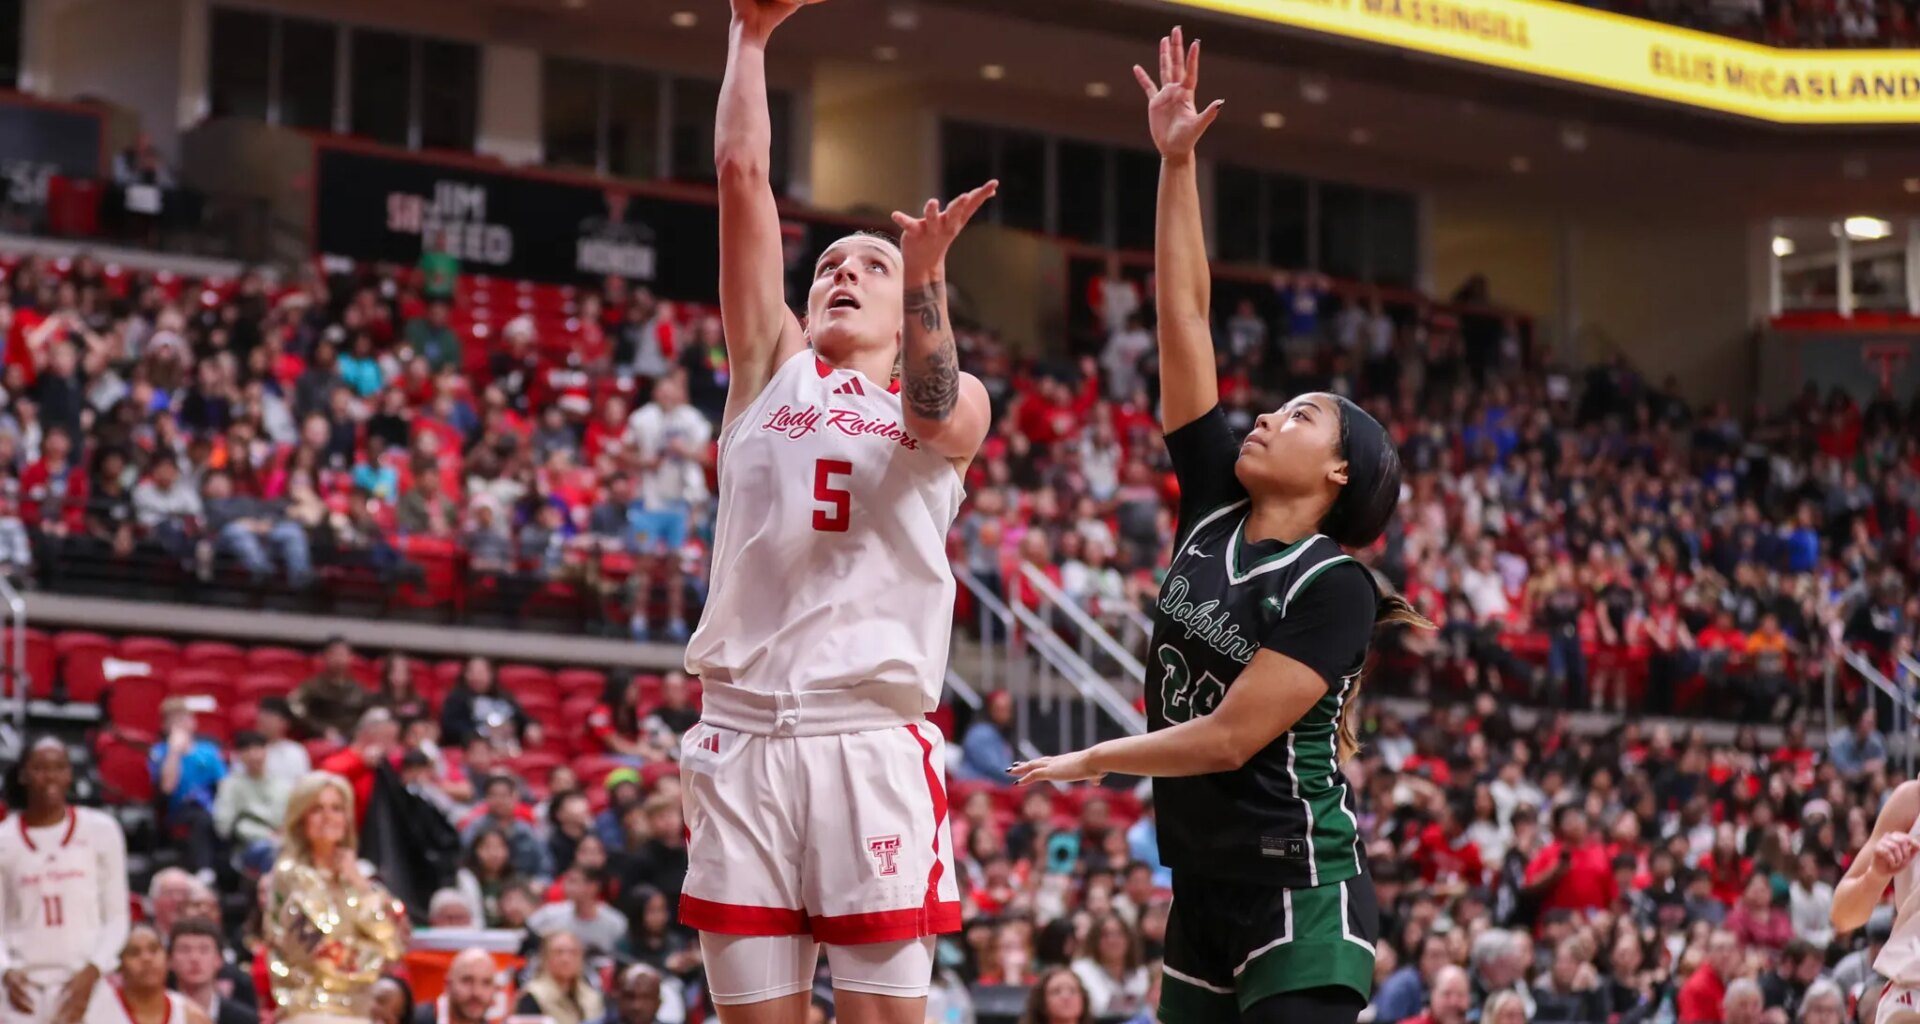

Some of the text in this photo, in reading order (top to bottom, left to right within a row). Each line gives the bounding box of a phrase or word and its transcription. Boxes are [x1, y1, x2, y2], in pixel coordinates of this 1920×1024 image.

[1649, 44, 1716, 87] ELLIS
[762, 405, 918, 450] Lady Raiders
[812, 459, 852, 532] 5
[1291, 844, 1300, 853] M
[43, 895, 63, 927] 11
